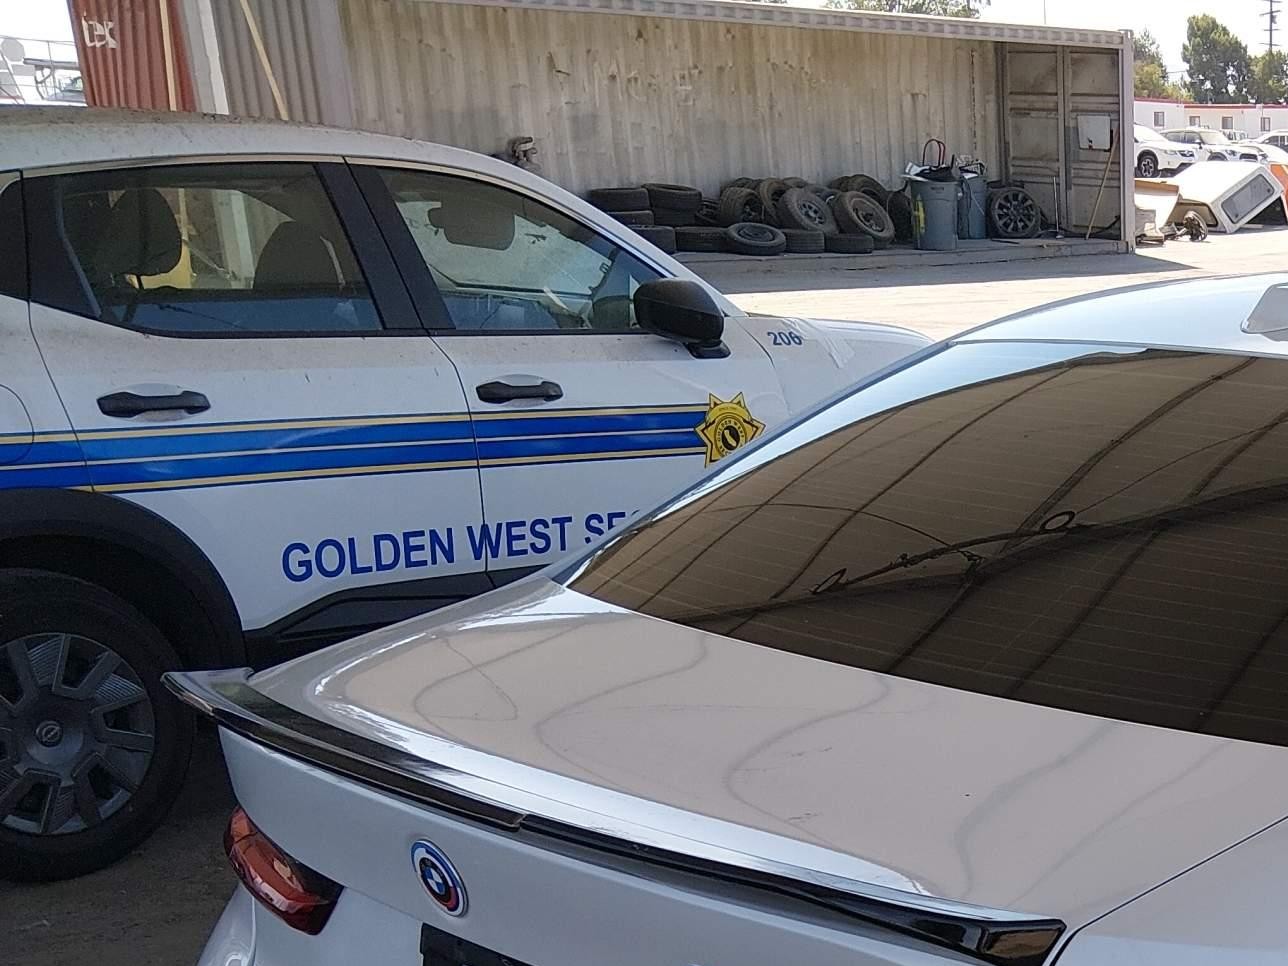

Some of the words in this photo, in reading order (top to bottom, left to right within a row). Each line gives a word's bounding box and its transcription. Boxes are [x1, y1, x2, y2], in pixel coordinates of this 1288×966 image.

[767, 330, 803, 346] 206
[282, 526, 455, 583] GOLDEN
[467, 516, 573, 562] WEST
